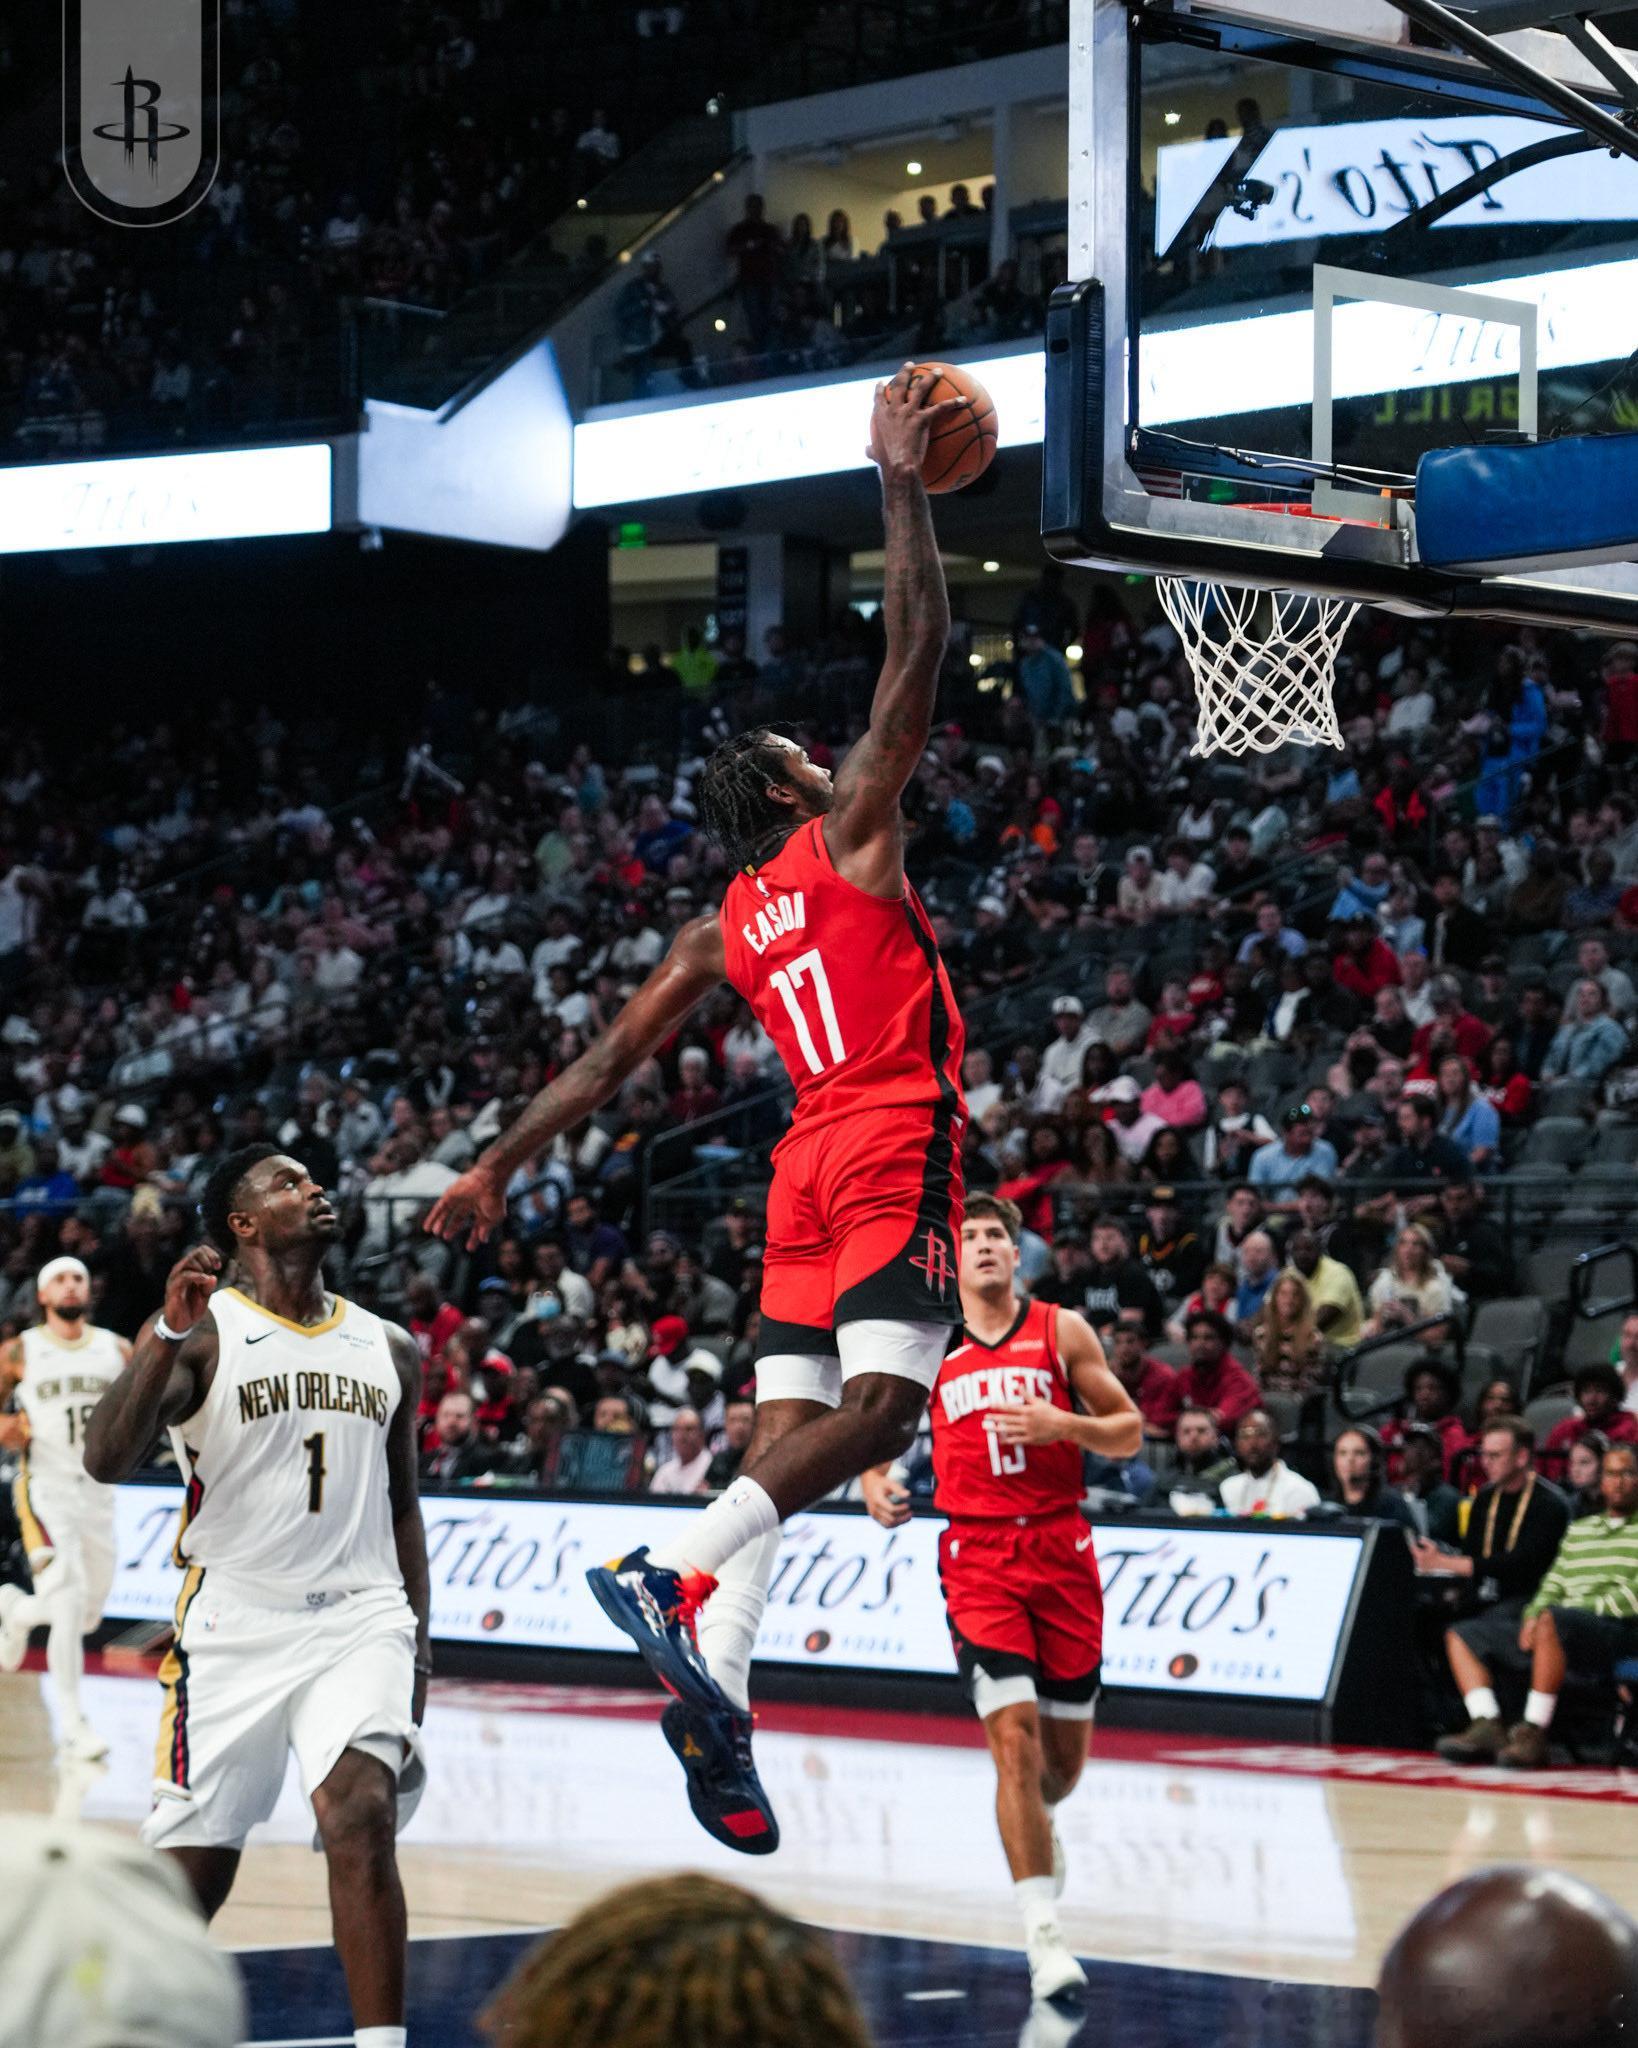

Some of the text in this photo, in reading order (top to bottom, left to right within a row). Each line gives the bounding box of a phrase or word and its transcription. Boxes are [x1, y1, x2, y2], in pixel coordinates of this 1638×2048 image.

[743, 892, 805, 954] EASON
[769, 948, 846, 1075] 17
[238, 1371, 388, 1427] NEW ORLEANS
[940, 1367, 1053, 1423] ROCKETS
[303, 1432, 326, 1523] 1
[767, 1524, 913, 1611] ito's
